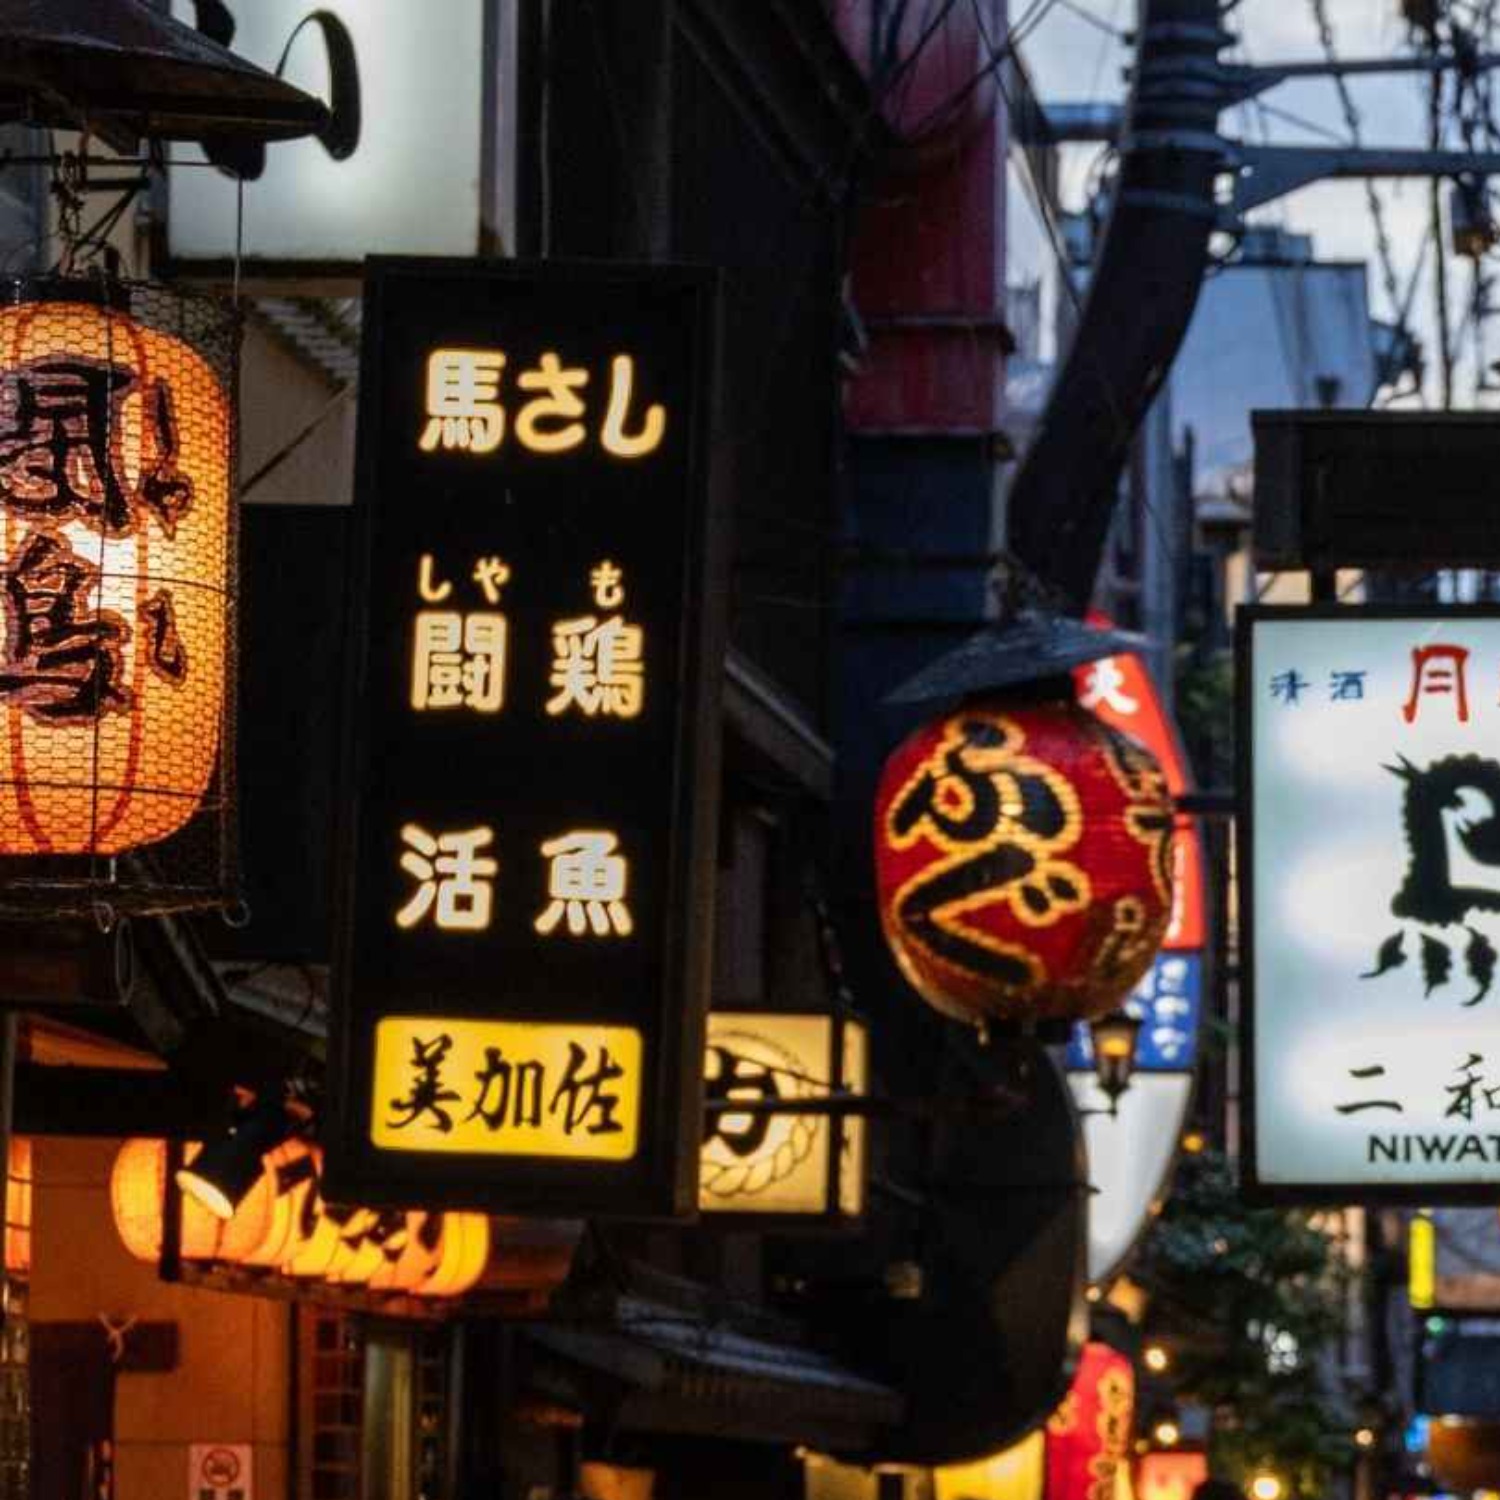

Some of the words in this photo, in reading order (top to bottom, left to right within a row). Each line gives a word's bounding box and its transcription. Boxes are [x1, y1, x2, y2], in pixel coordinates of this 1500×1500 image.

[418, 349, 666, 458] 馬さし
[386, 1033, 625, 1136] 美加佐
